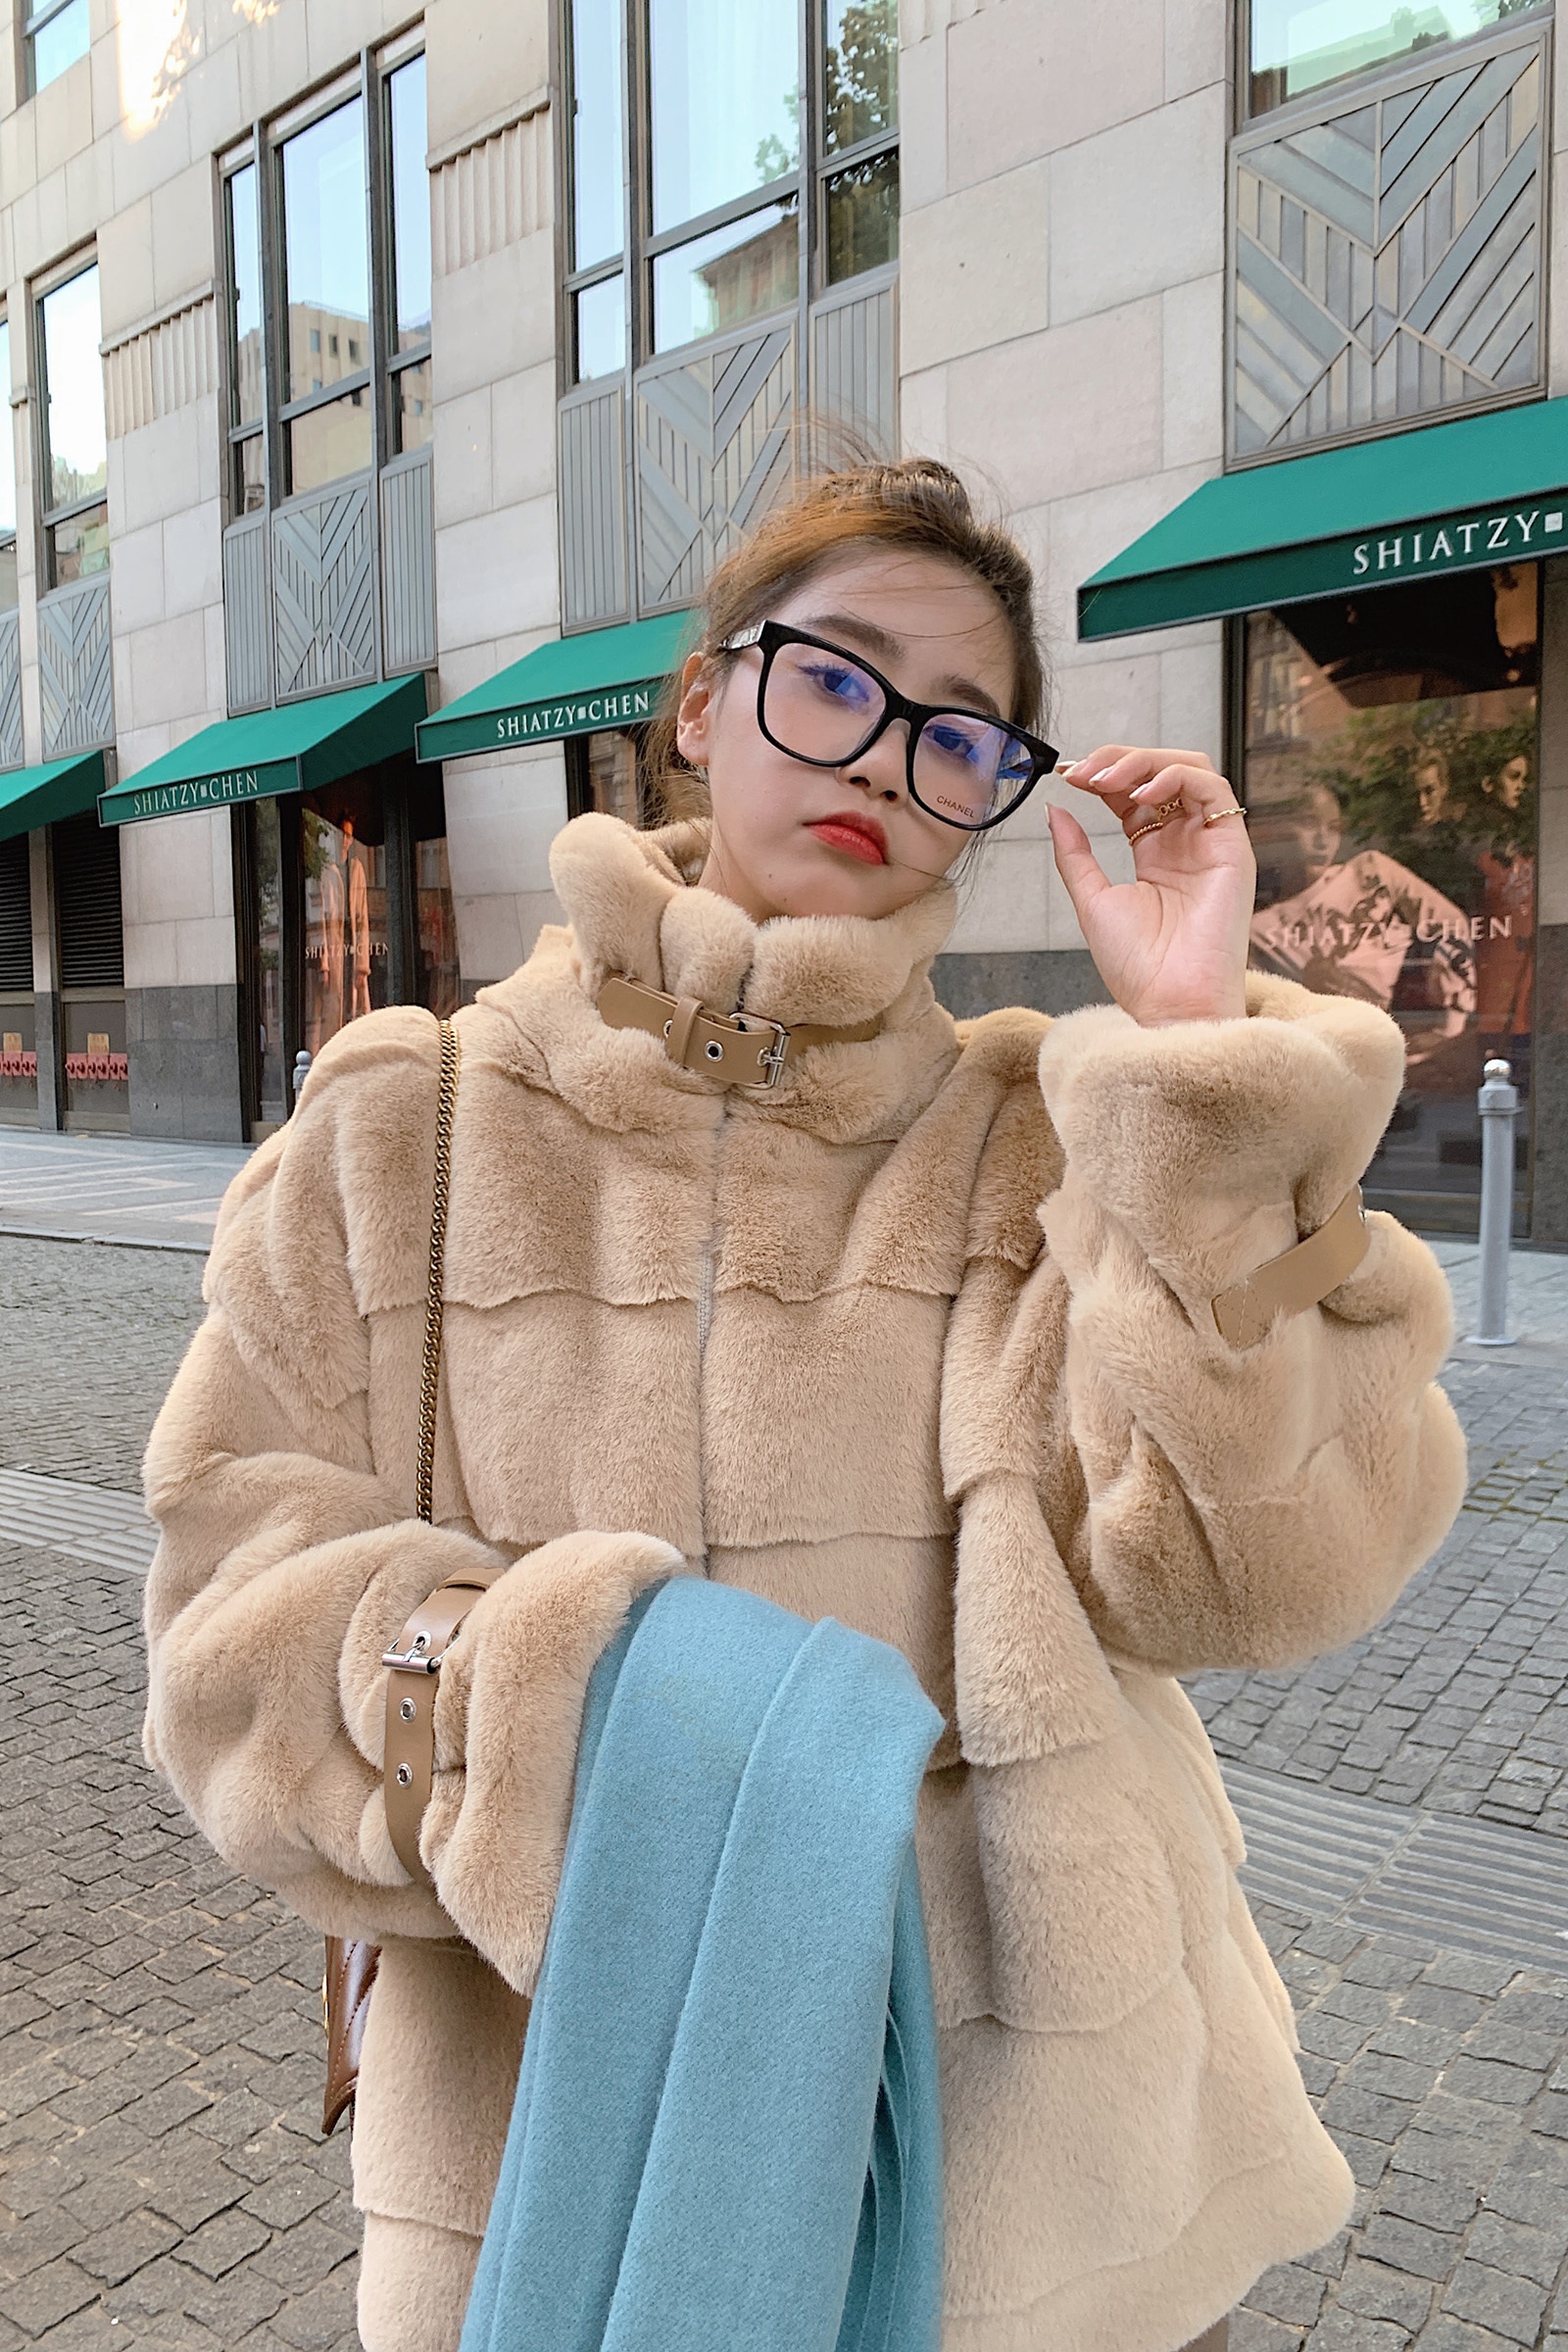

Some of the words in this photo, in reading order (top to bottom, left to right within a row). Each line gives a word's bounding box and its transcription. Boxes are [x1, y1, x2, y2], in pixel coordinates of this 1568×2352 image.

[1353, 511, 1540, 575] SHIATZY
[497, 705, 576, 738] SHIATZY
[588, 691, 650, 721] CHEN
[133, 782, 199, 815] SHIATZY
[209, 770, 258, 800] CHEN
[936, 795, 975, 818] CHANEL
[1416, 914, 1512, 942] CHEN
